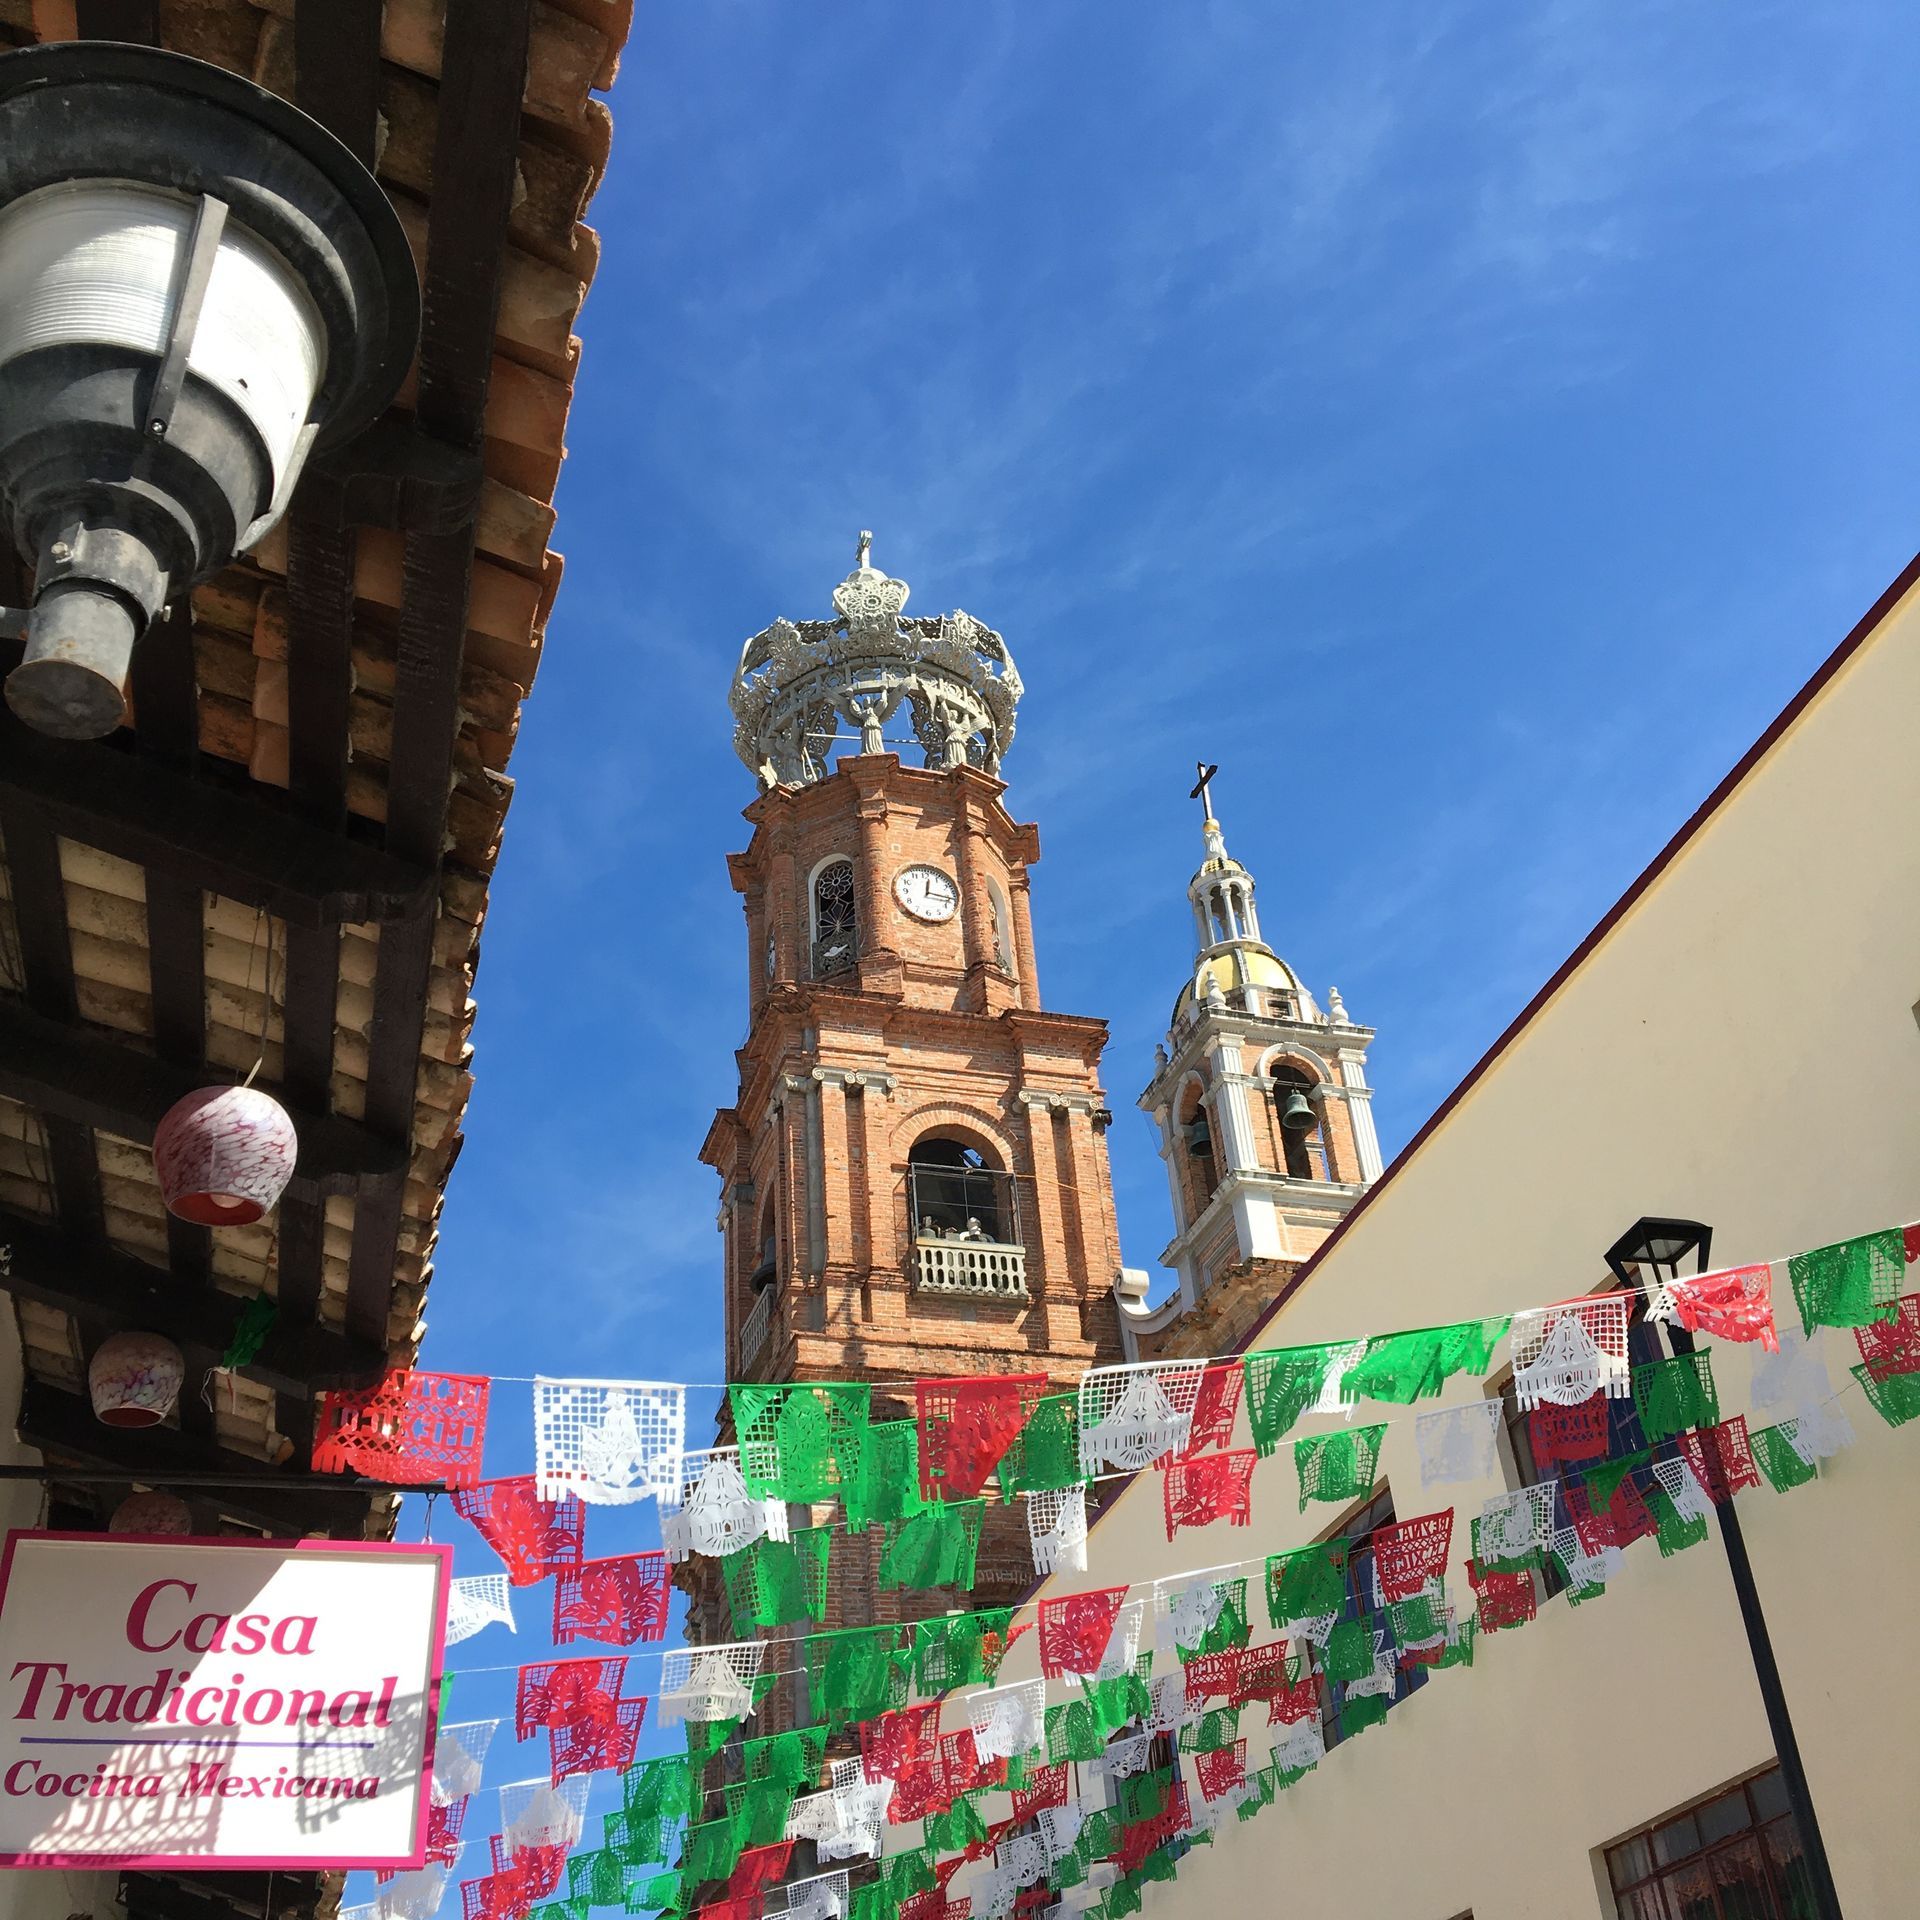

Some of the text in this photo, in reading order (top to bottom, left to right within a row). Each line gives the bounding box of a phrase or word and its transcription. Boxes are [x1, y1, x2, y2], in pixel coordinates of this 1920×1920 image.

[921, 872, 930, 880] 12
[925, 909, 932, 917] 6
[126, 1579, 318, 1655] Casa
[9, 1662, 398, 1727] Tradicional
[4, 1760, 379, 1799] Cocina Mexicana
